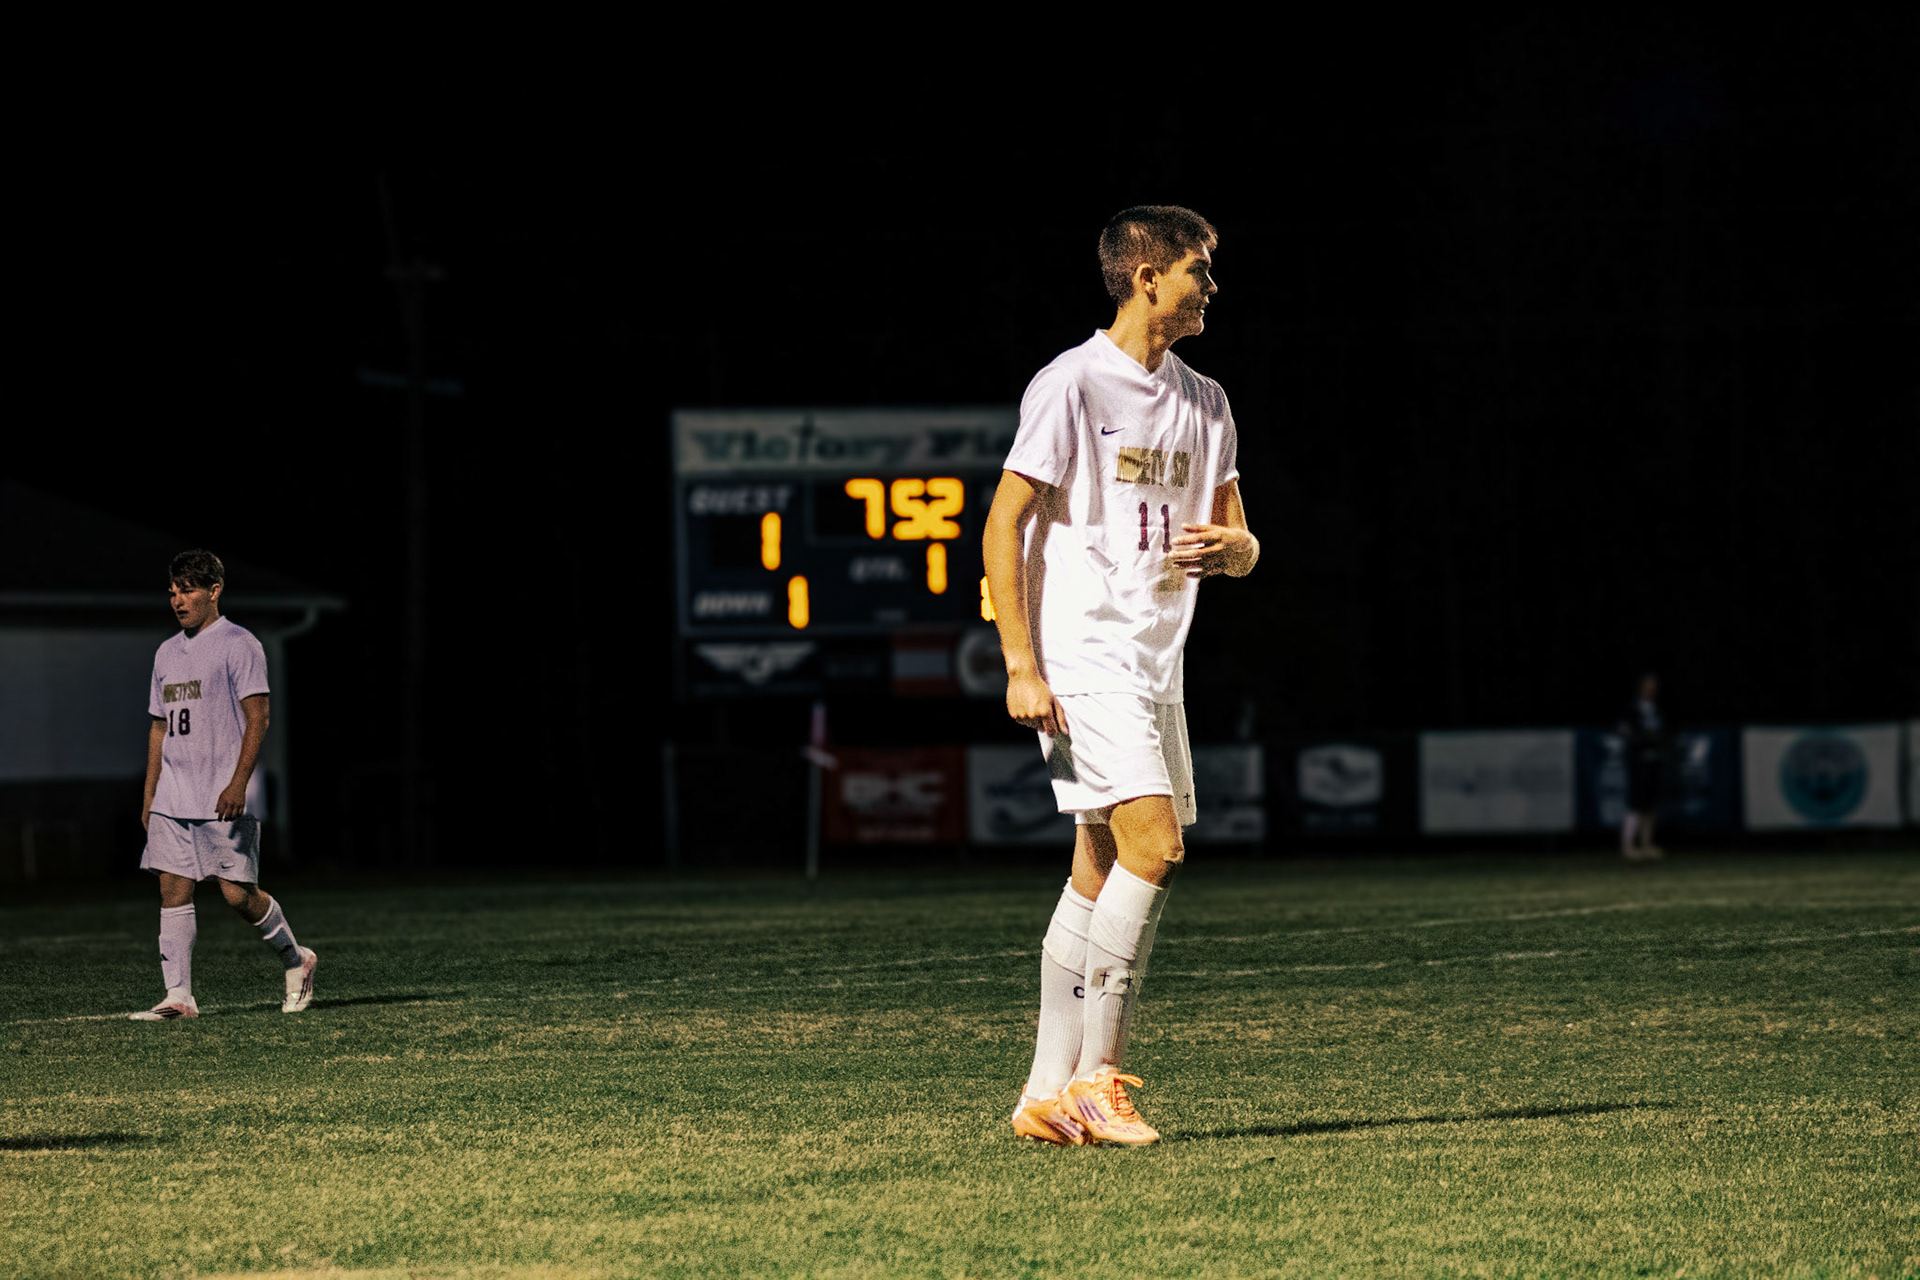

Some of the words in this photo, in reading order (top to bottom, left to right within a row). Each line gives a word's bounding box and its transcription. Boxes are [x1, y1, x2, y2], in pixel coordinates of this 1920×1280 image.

[760, 511, 782, 572] 1
[1138, 501, 1172, 553] 11
[925, 541, 948, 595] 1
[787, 574, 810, 630] 1
[169, 708, 190, 737] 18
